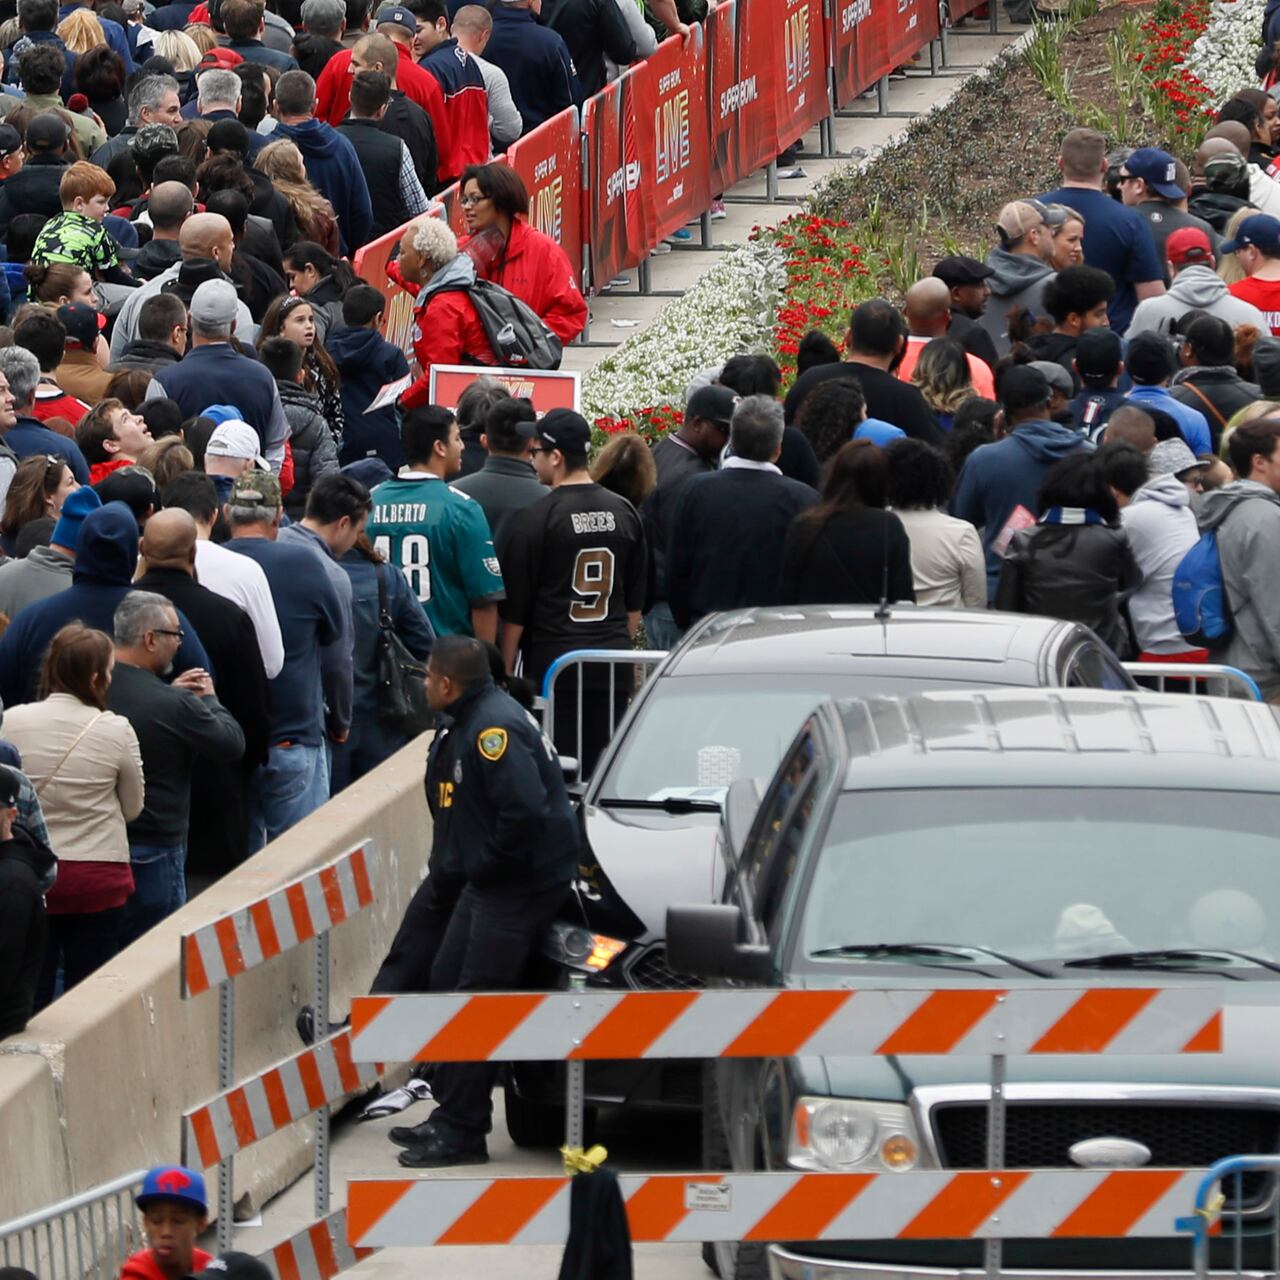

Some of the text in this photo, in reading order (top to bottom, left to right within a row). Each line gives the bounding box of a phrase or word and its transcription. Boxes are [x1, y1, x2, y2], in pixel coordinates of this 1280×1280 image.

[655, 89, 690, 184] LIVE
[373, 503, 426, 523] ALBERTO
[571, 511, 616, 535] BREES
[569, 546, 616, 622] 9
